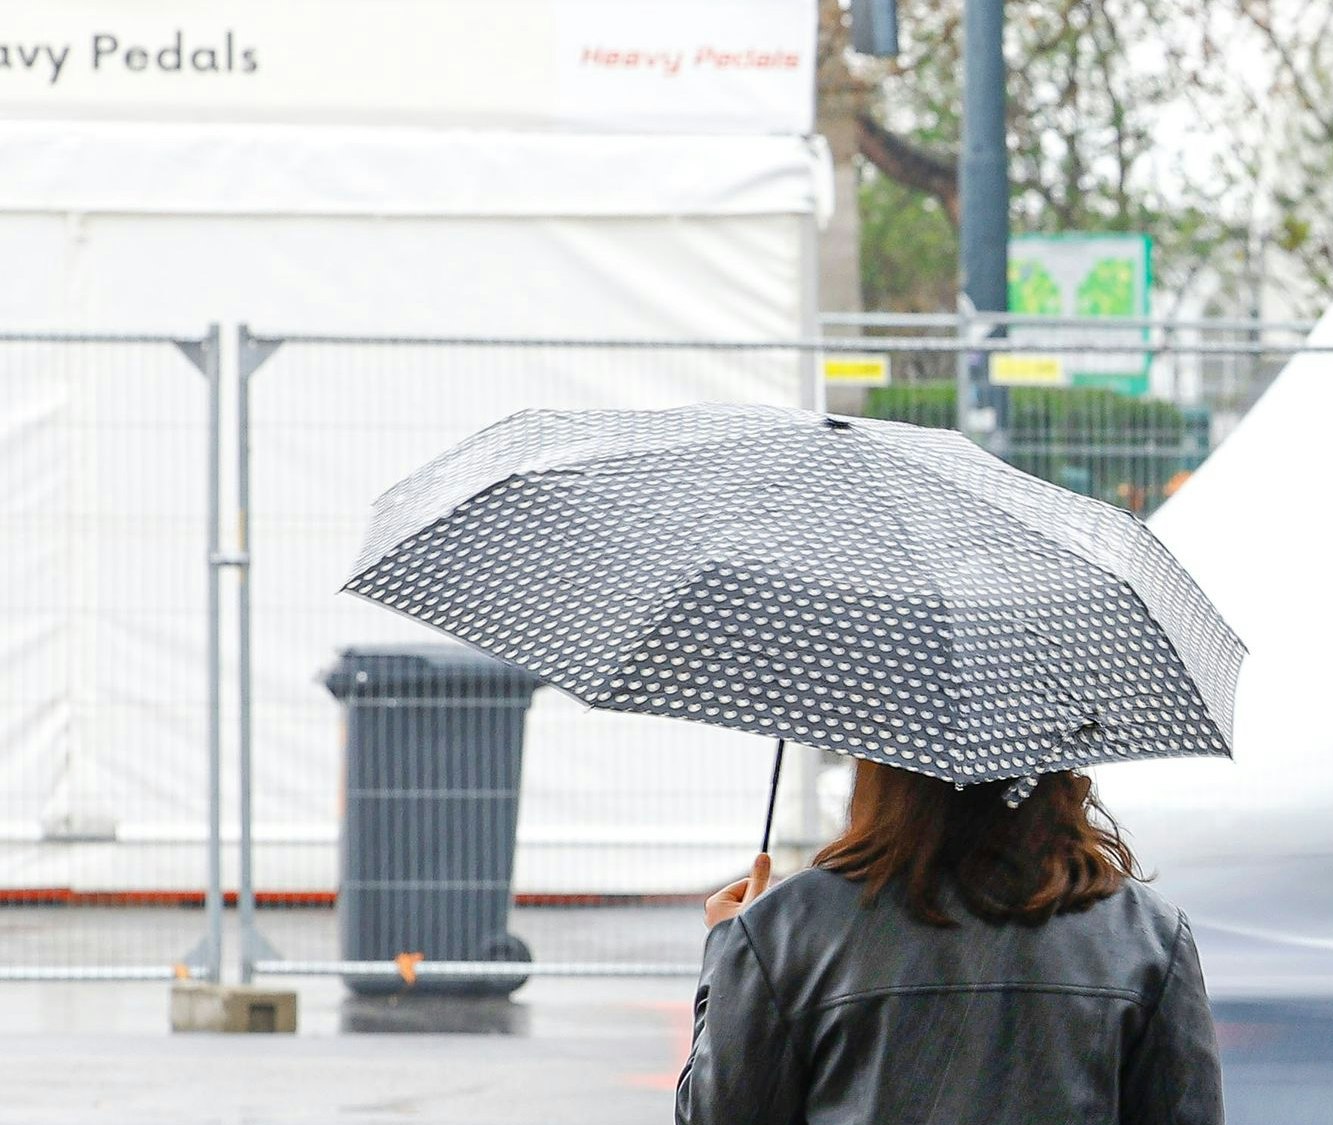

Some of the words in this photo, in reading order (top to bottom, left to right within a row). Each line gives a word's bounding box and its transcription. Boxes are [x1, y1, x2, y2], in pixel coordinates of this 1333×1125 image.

[92, 30, 258, 72] Pedals
[581, 46, 683, 77] Heavy
[694, 46, 800, 69] Pedals
